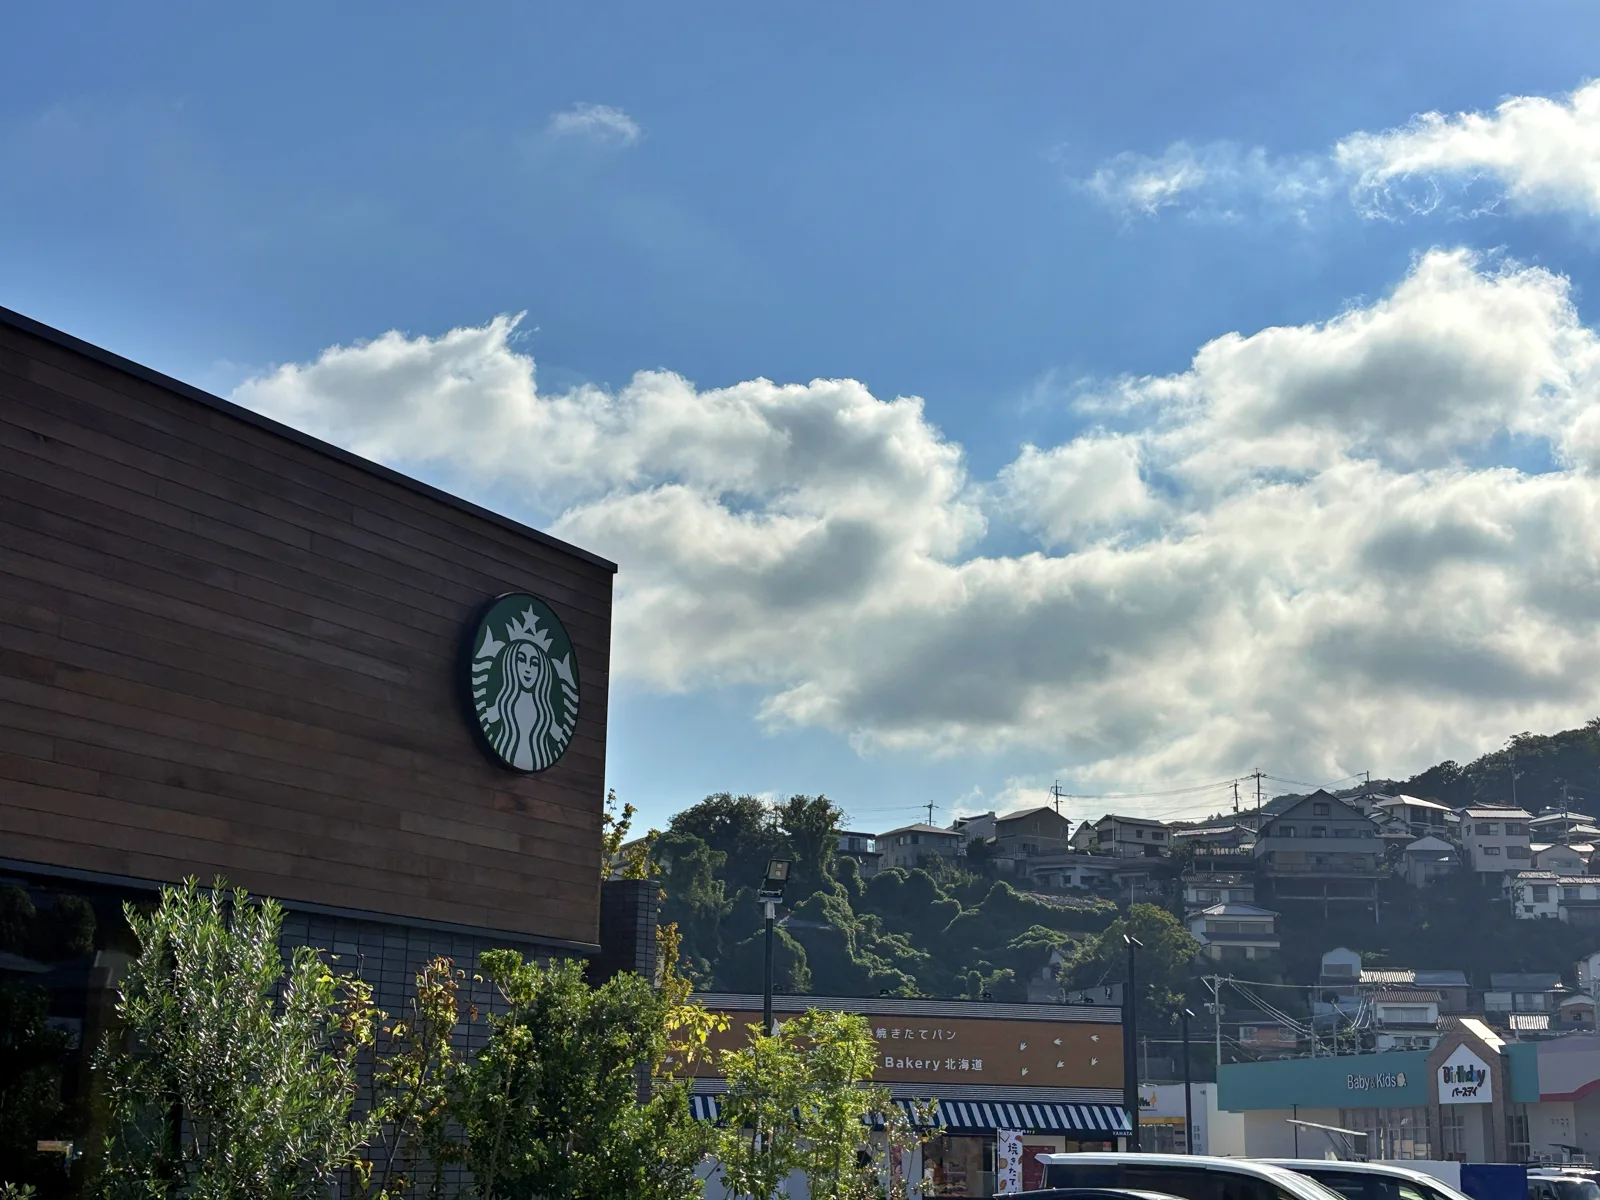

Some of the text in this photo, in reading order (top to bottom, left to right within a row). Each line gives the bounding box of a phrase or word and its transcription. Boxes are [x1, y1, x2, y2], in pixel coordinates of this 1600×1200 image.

[884, 1056, 983, 1071] Bakery 北海道
[1442, 1065, 1486, 1087] Birthday
[1008, 1143, 1018, 1194] 焼きたて
